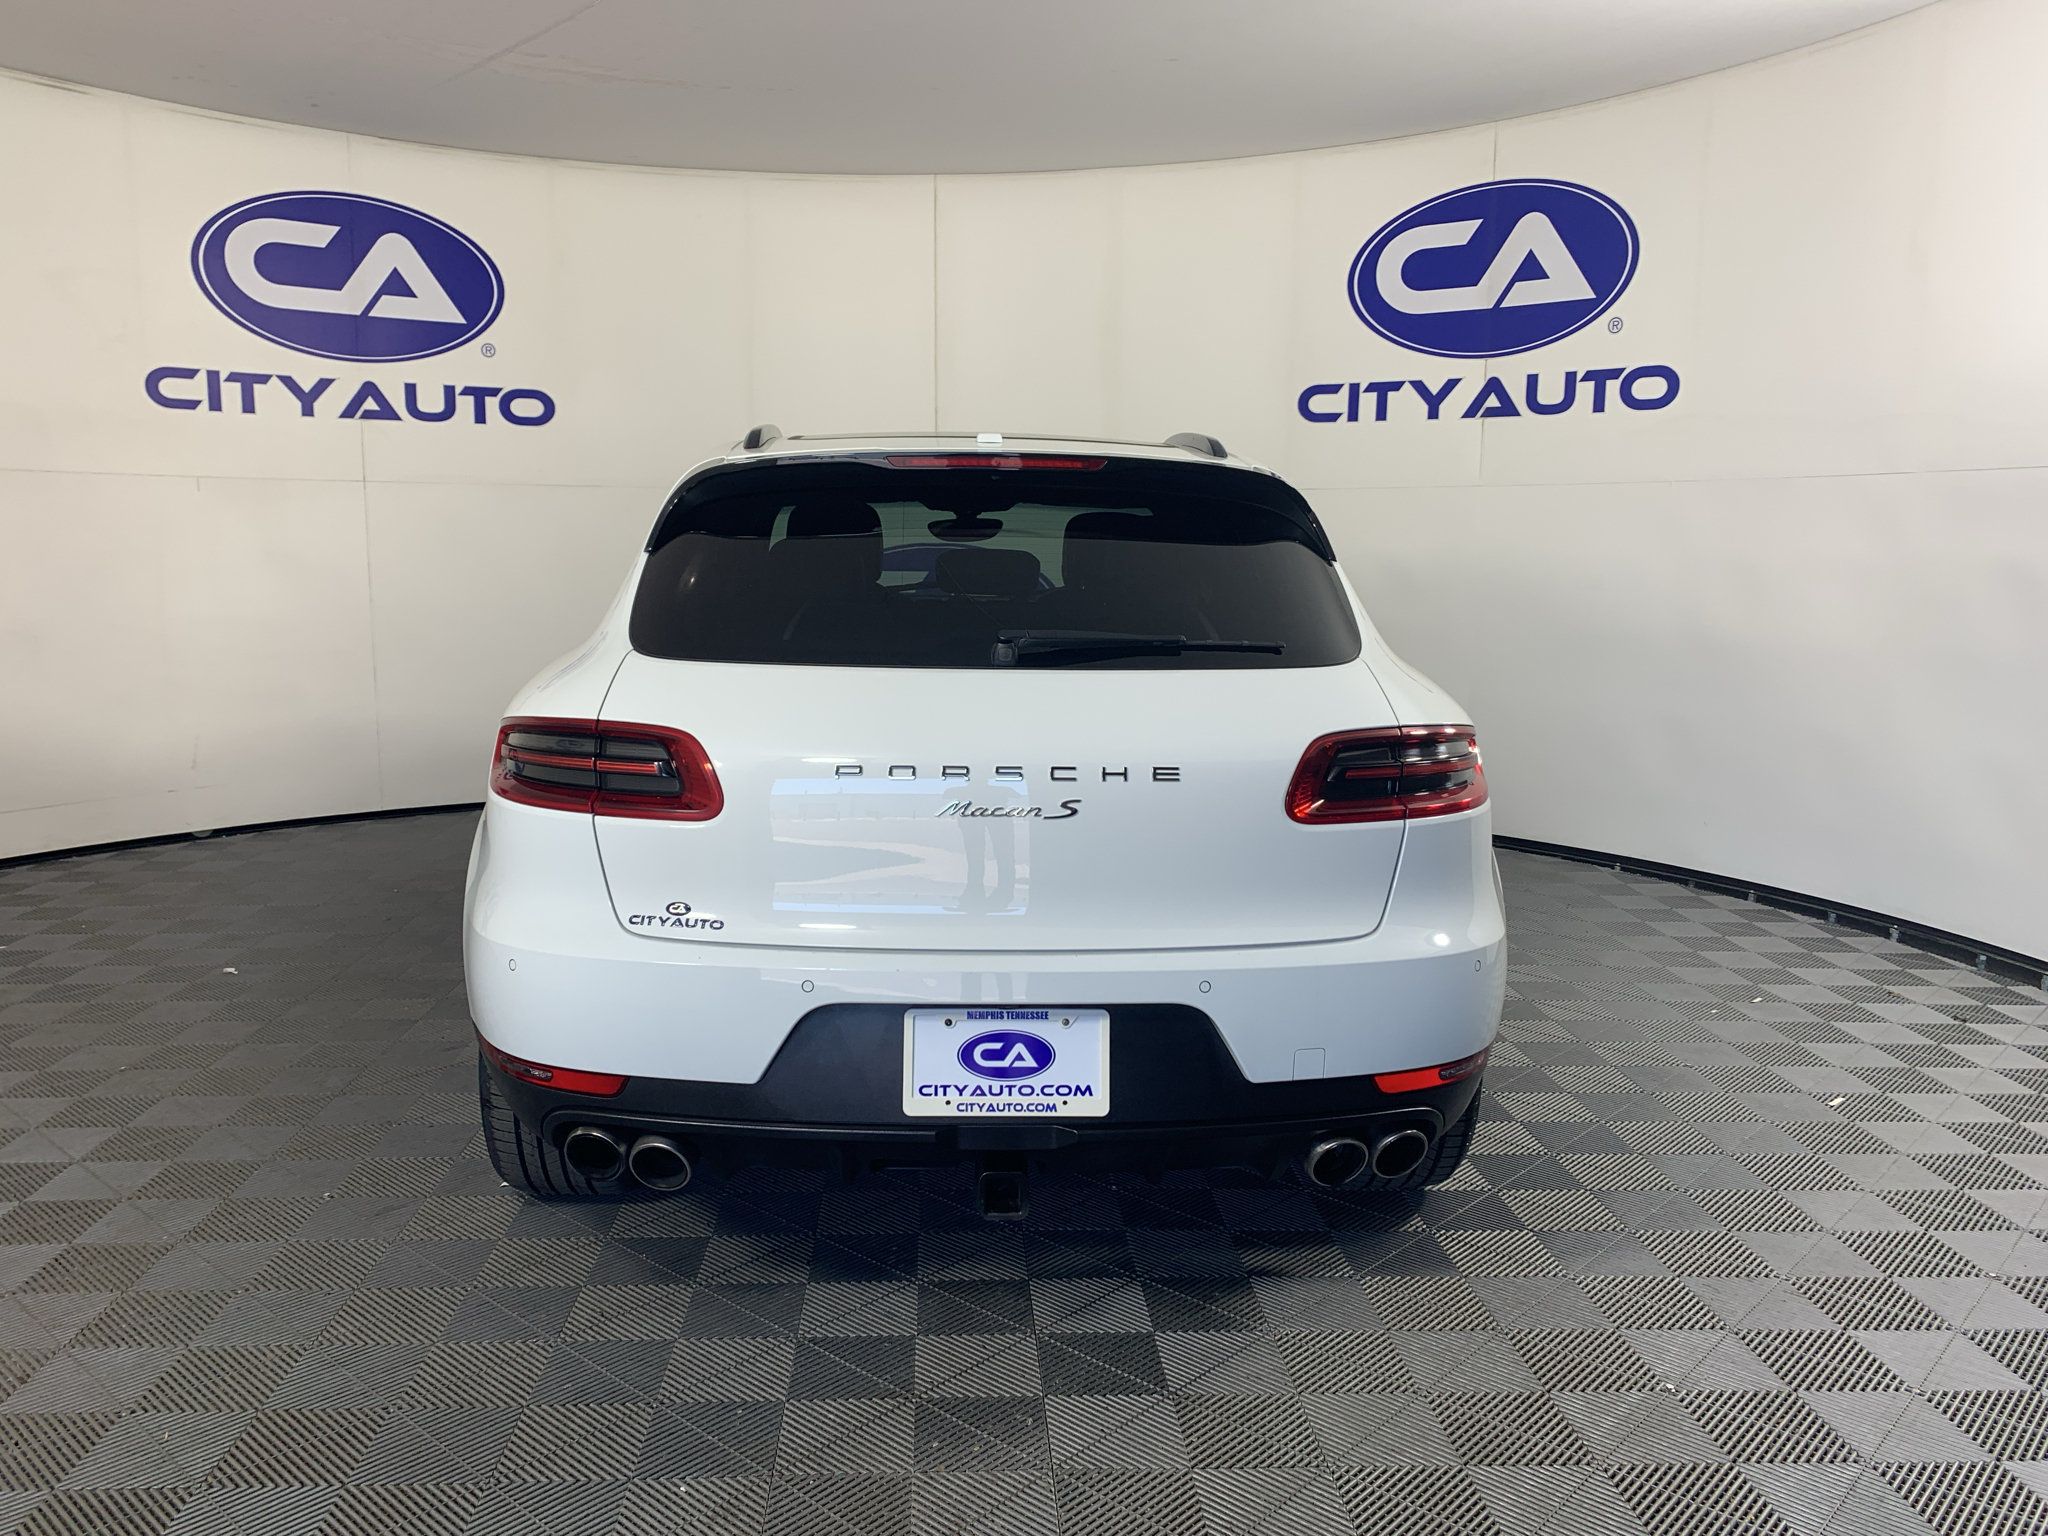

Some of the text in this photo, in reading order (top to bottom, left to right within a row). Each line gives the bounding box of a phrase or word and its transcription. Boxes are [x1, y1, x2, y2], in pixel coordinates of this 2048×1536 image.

[223, 217, 468, 324] CA
[1375, 211, 1597, 315] CA
[834, 764, 1182, 783] PORSCHE
[934, 799, 1083, 820] Macan S
[966, 1010, 1049, 1021] MEMPHIS TENNESSEE
[973, 1042, 1040, 1068] CA
[918, 1084, 1094, 1097] CITYAUTO.COM
[956, 1102, 1058, 1113] CITYAUTO.COM
